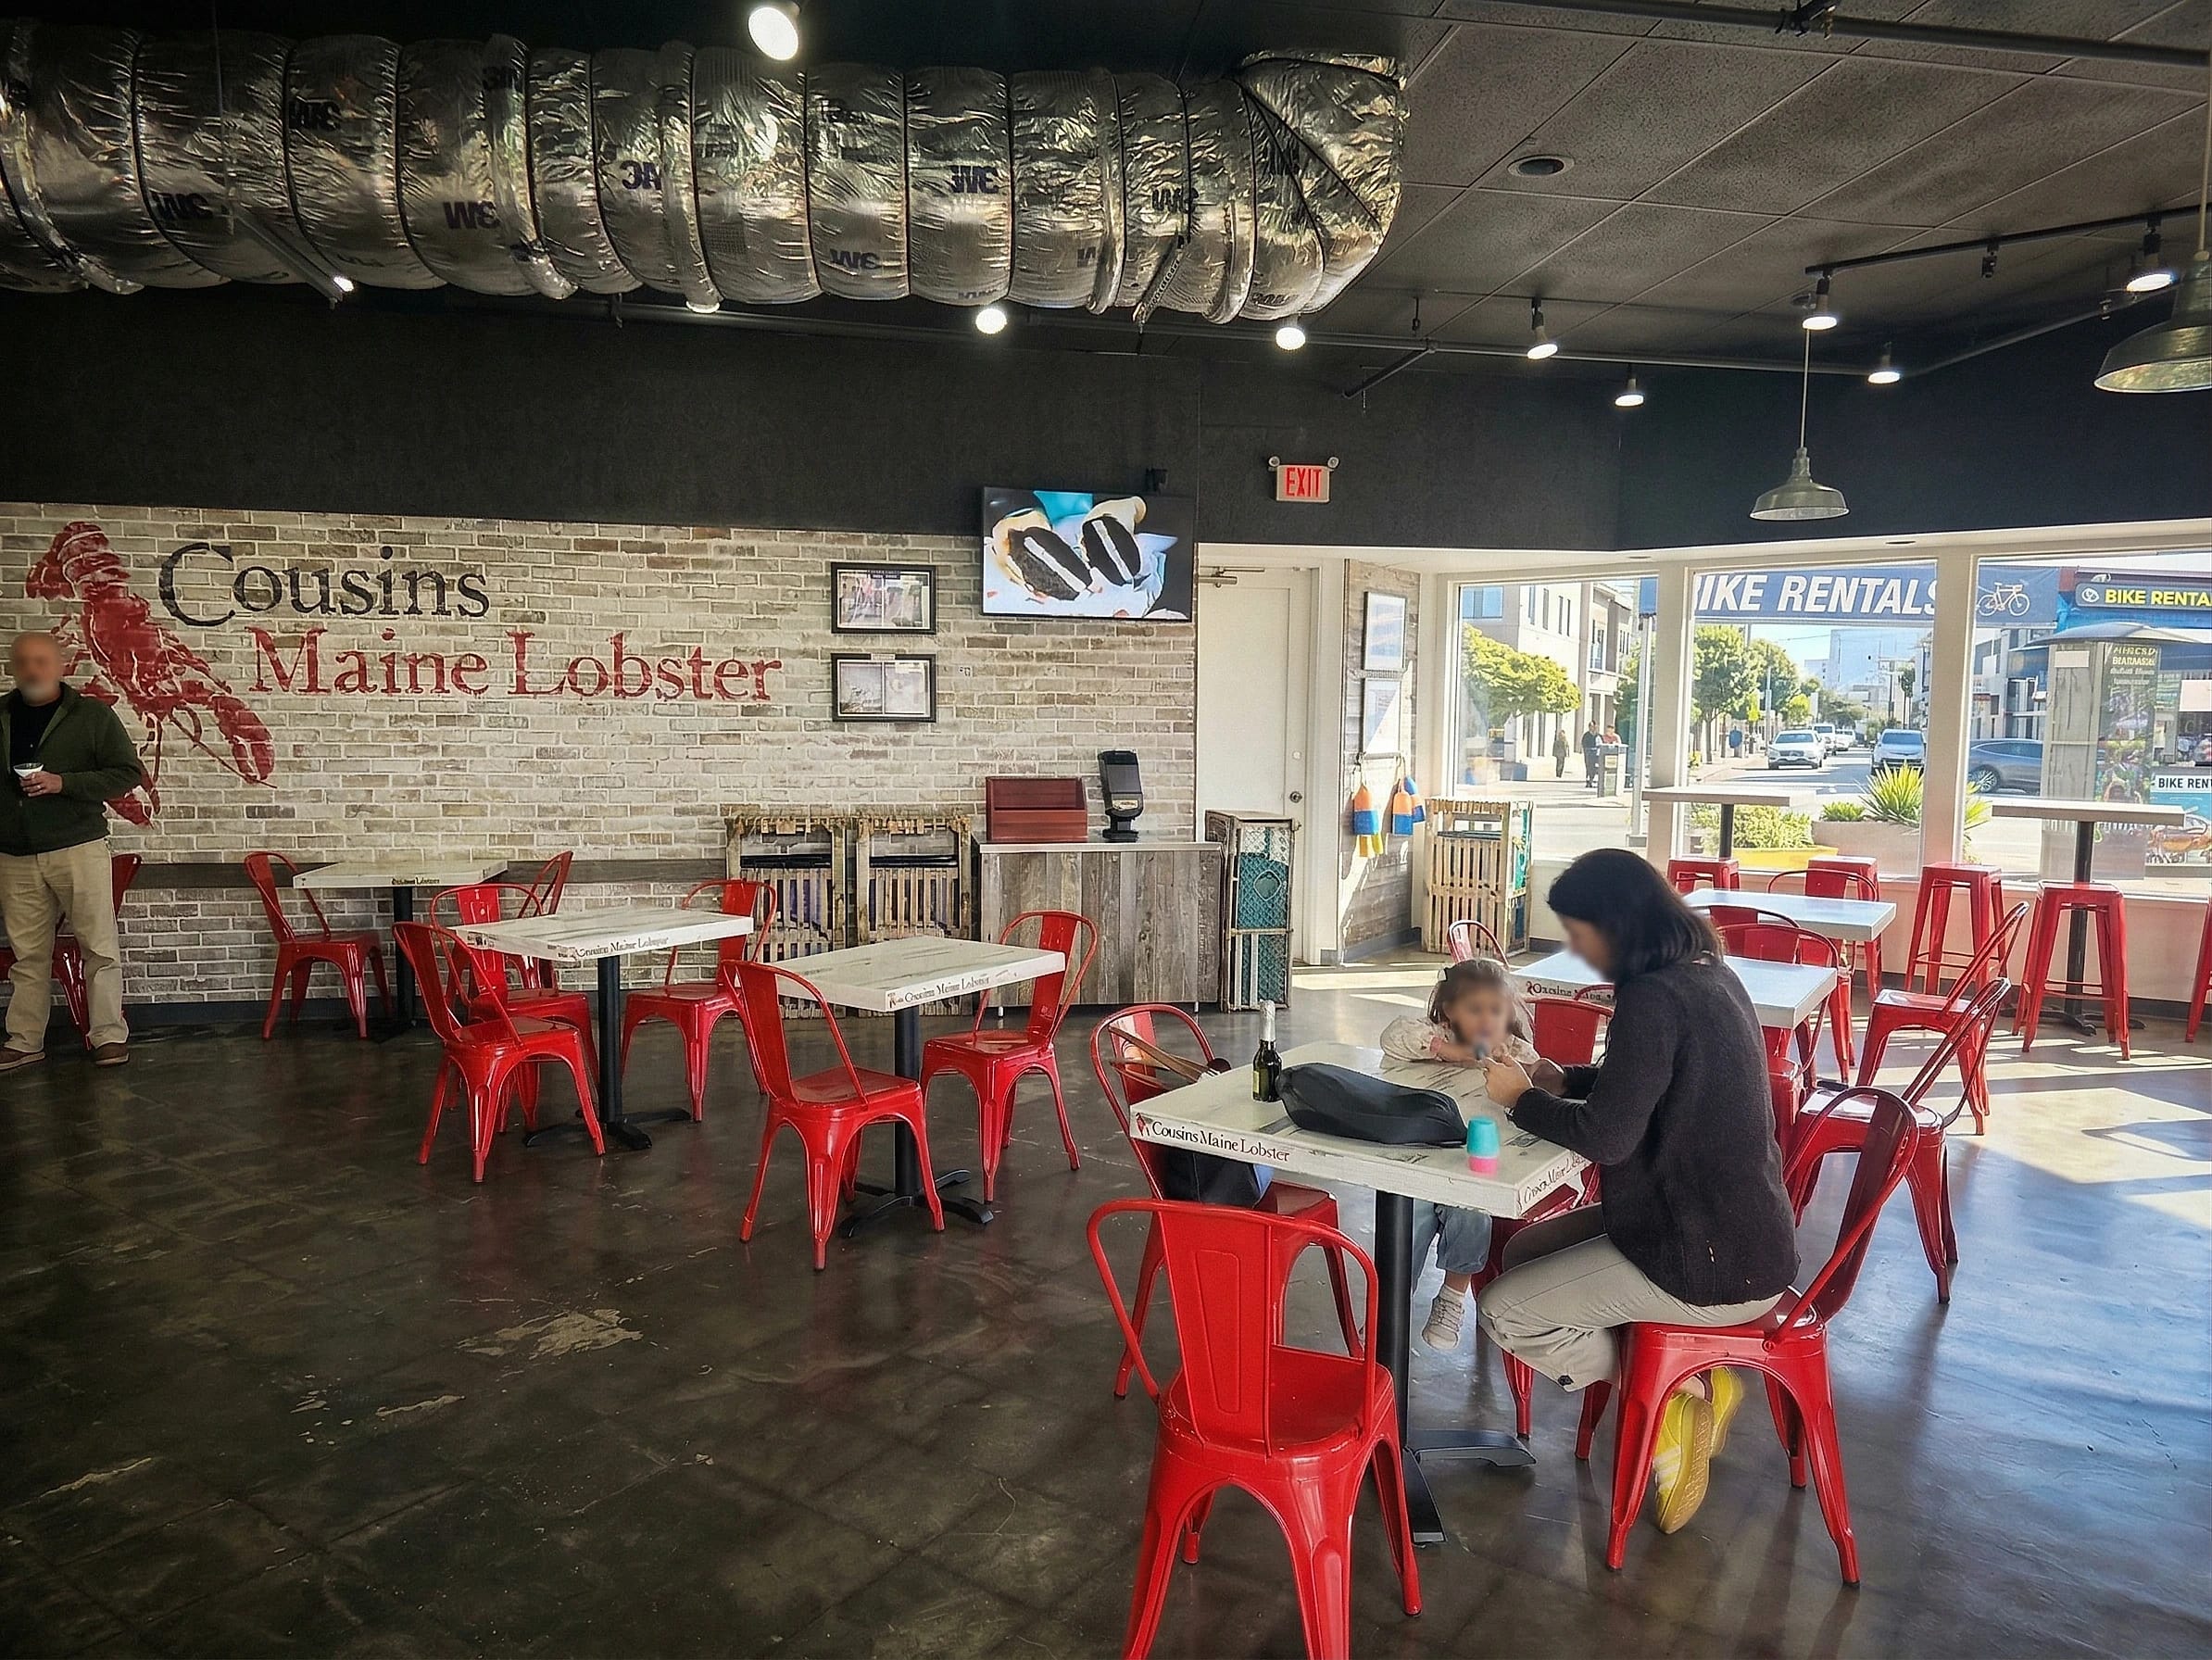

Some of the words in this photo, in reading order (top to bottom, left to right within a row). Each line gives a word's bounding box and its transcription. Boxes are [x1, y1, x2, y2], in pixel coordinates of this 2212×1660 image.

[1286, 467, 1323, 497] EXIT
[159, 542, 490, 628] Cousins
[1695, 574, 1768, 610] IKE
[2105, 588, 2146, 605] BIKE
[2151, 590, 2212, 607] RENTA
[246, 626, 490, 696] Maine
[507, 631, 782, 701] Lobster
[2158, 777, 2183, 788] BIKE
[1151, 1121, 1199, 1143] Cousins
[1200, 1130, 1238, 1151] Maine
[1240, 1138, 1290, 1163] Lobster
